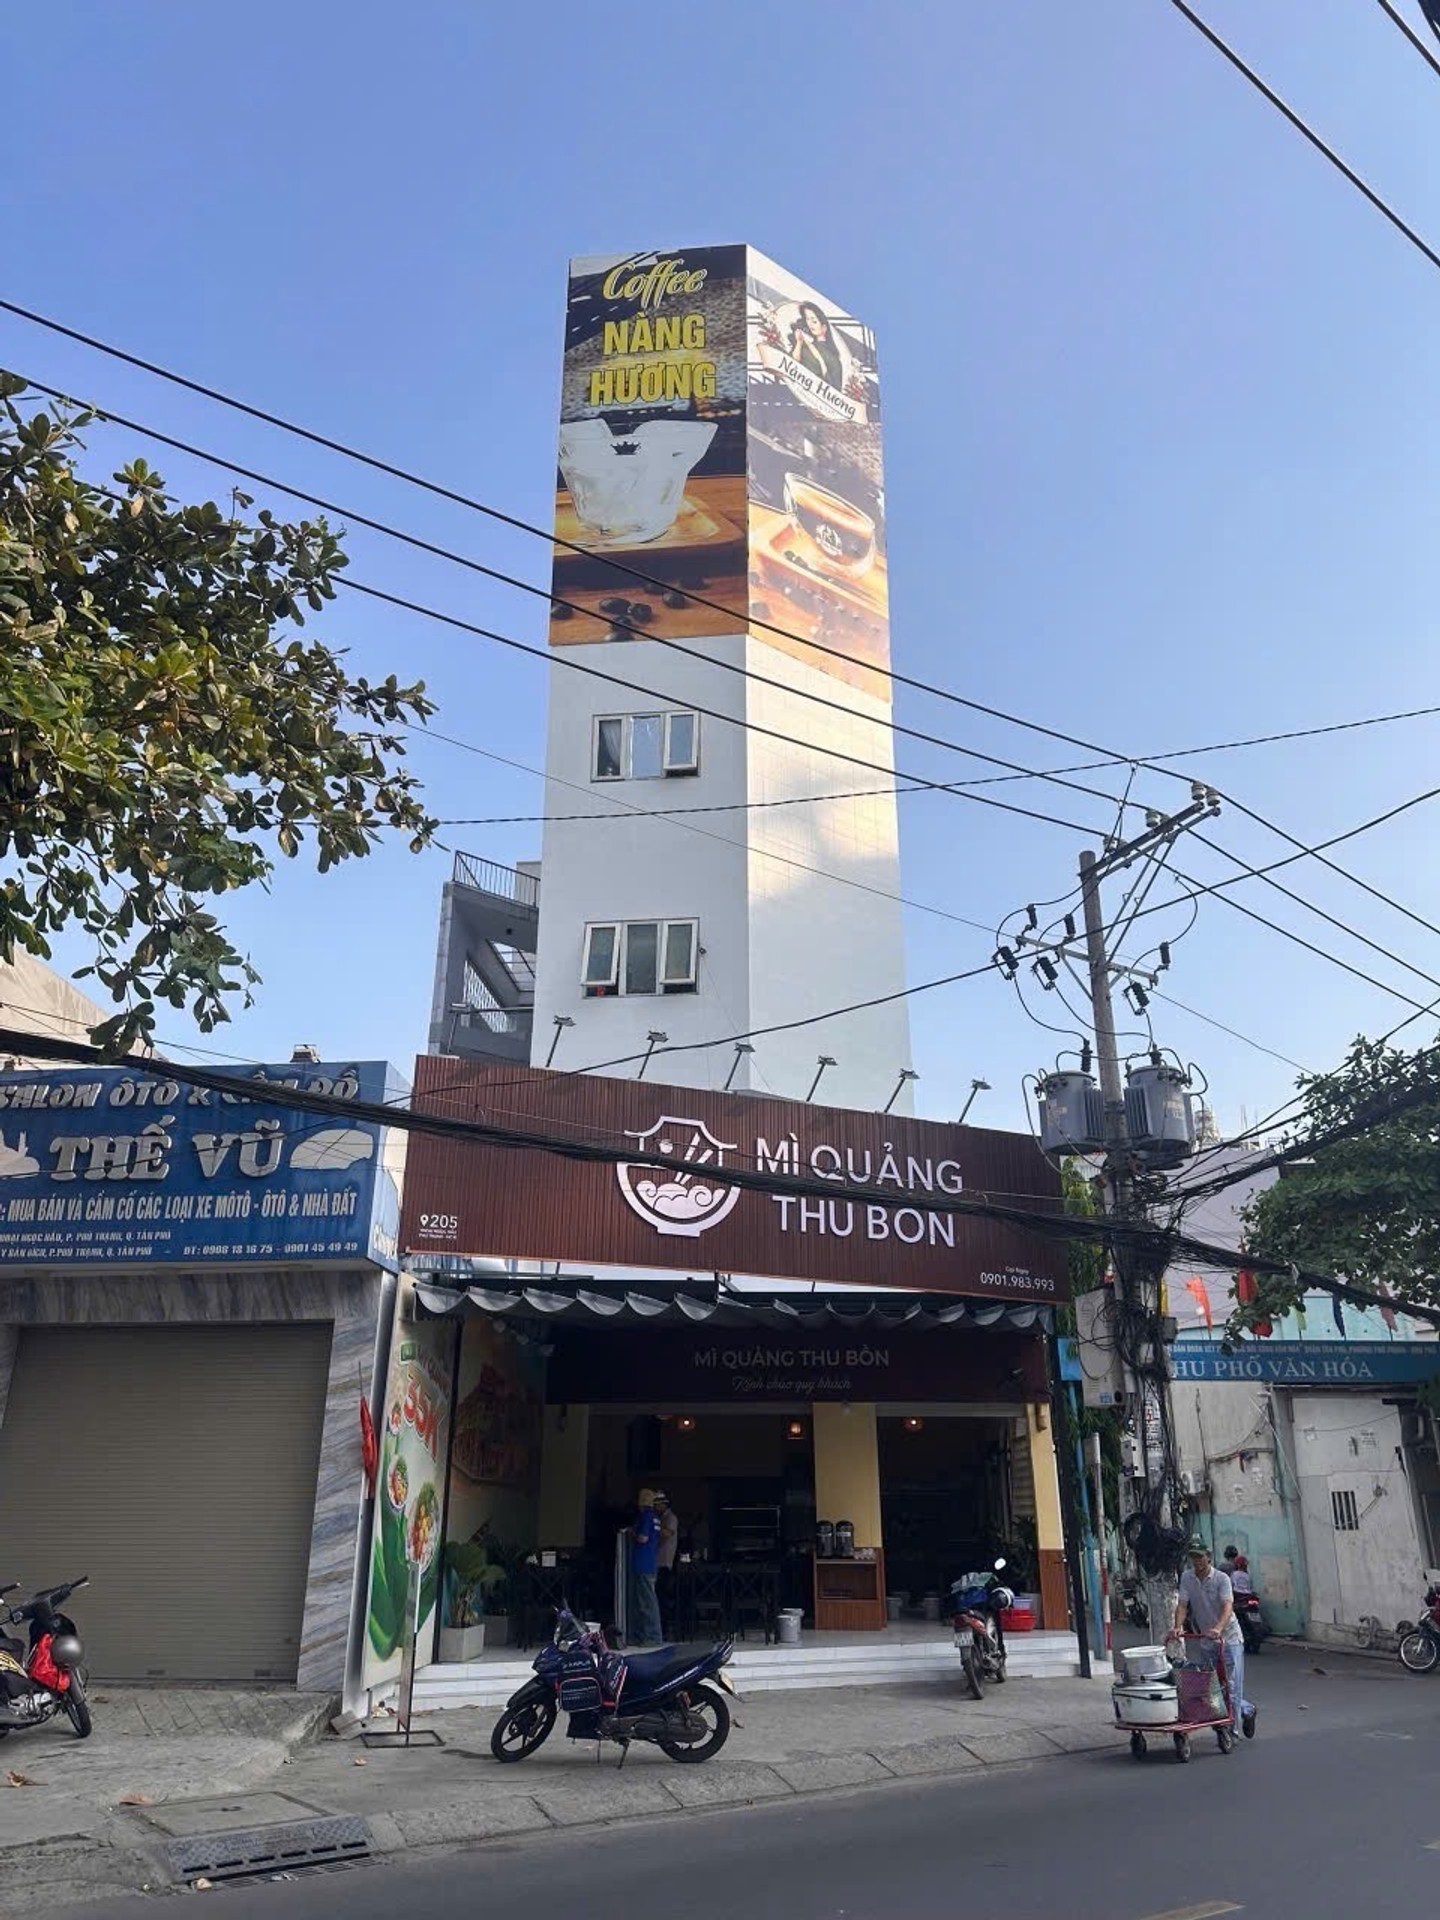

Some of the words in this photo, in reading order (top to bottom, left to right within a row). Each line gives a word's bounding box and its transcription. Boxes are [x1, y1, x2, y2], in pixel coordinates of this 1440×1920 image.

[602, 258, 708, 310] Coffee
[603, 312, 706, 356] NÀNG
[590, 362, 717, 407] HƯƠNG
[50, 1115, 176, 1181] THẾ
[191, 1119, 288, 1178] VŨ
[757, 1132, 799, 1176] MÌ
[811, 1142, 964, 1194] QUẢNG
[7, 1198, 36, 1222] MUA
[37, 1193, 66, 1221] BÁN
[66, 1193, 83, 1220] VÀ
[136, 1192, 163, 1220] CÁC
[164, 1195, 193, 1223] LOẠI
[195, 1195, 213, 1219] XE
[214, 1190, 252, 1219] MÔTÔ
[261, 1189, 287, 1218] ÔTÔ
[288, 1194, 300, 1218] &
[302, 1188, 329, 1217] NHÀ
[331, 1186, 358, 1216] ĐẤT
[429, 1214, 458, 1229] 205
[771, 1195, 854, 1237] THU
[980, 1272, 1055, 1291] 0901.983.993
[694, 1347, 717, 1367] MÌ
[721, 1345, 795, 1369] QUẢNG
[799, 1349, 840, 1367] THU
[845, 1344, 890, 1367] BỒN
[1172, 1360, 1206, 1377] HU
[1214, 1354, 1263, 1377] PHỐ
[1268, 1357, 1316, 1377] VĂN
